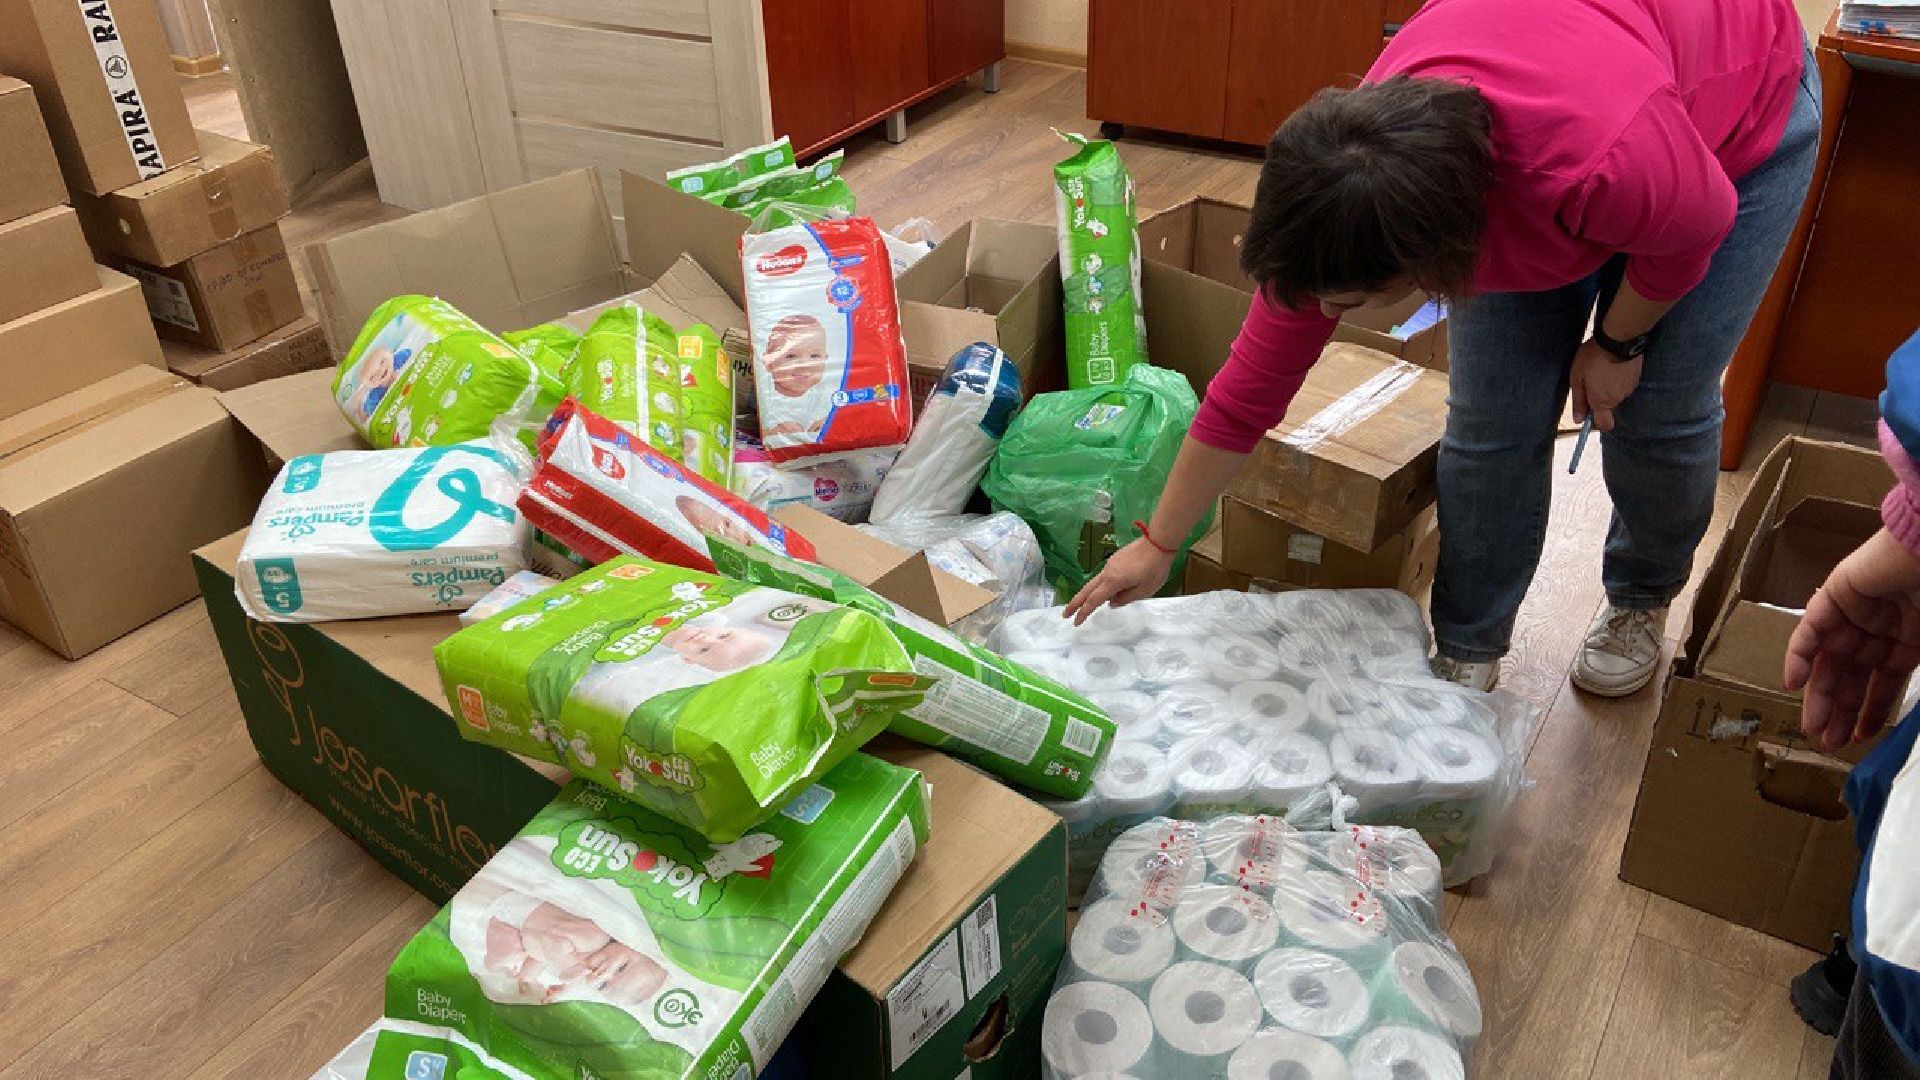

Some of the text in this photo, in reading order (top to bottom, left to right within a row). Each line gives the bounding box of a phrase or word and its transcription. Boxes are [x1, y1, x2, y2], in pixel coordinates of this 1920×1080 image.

[267, 510, 364, 529] Pampers
[409, 551, 499, 567] premium care
[411, 566, 505, 587] Pampers
[276, 592, 291, 608] 5
[307, 704, 498, 869] Josarflo
[563, 845, 602, 873] ECO
[417, 987, 452, 1006] Baby
